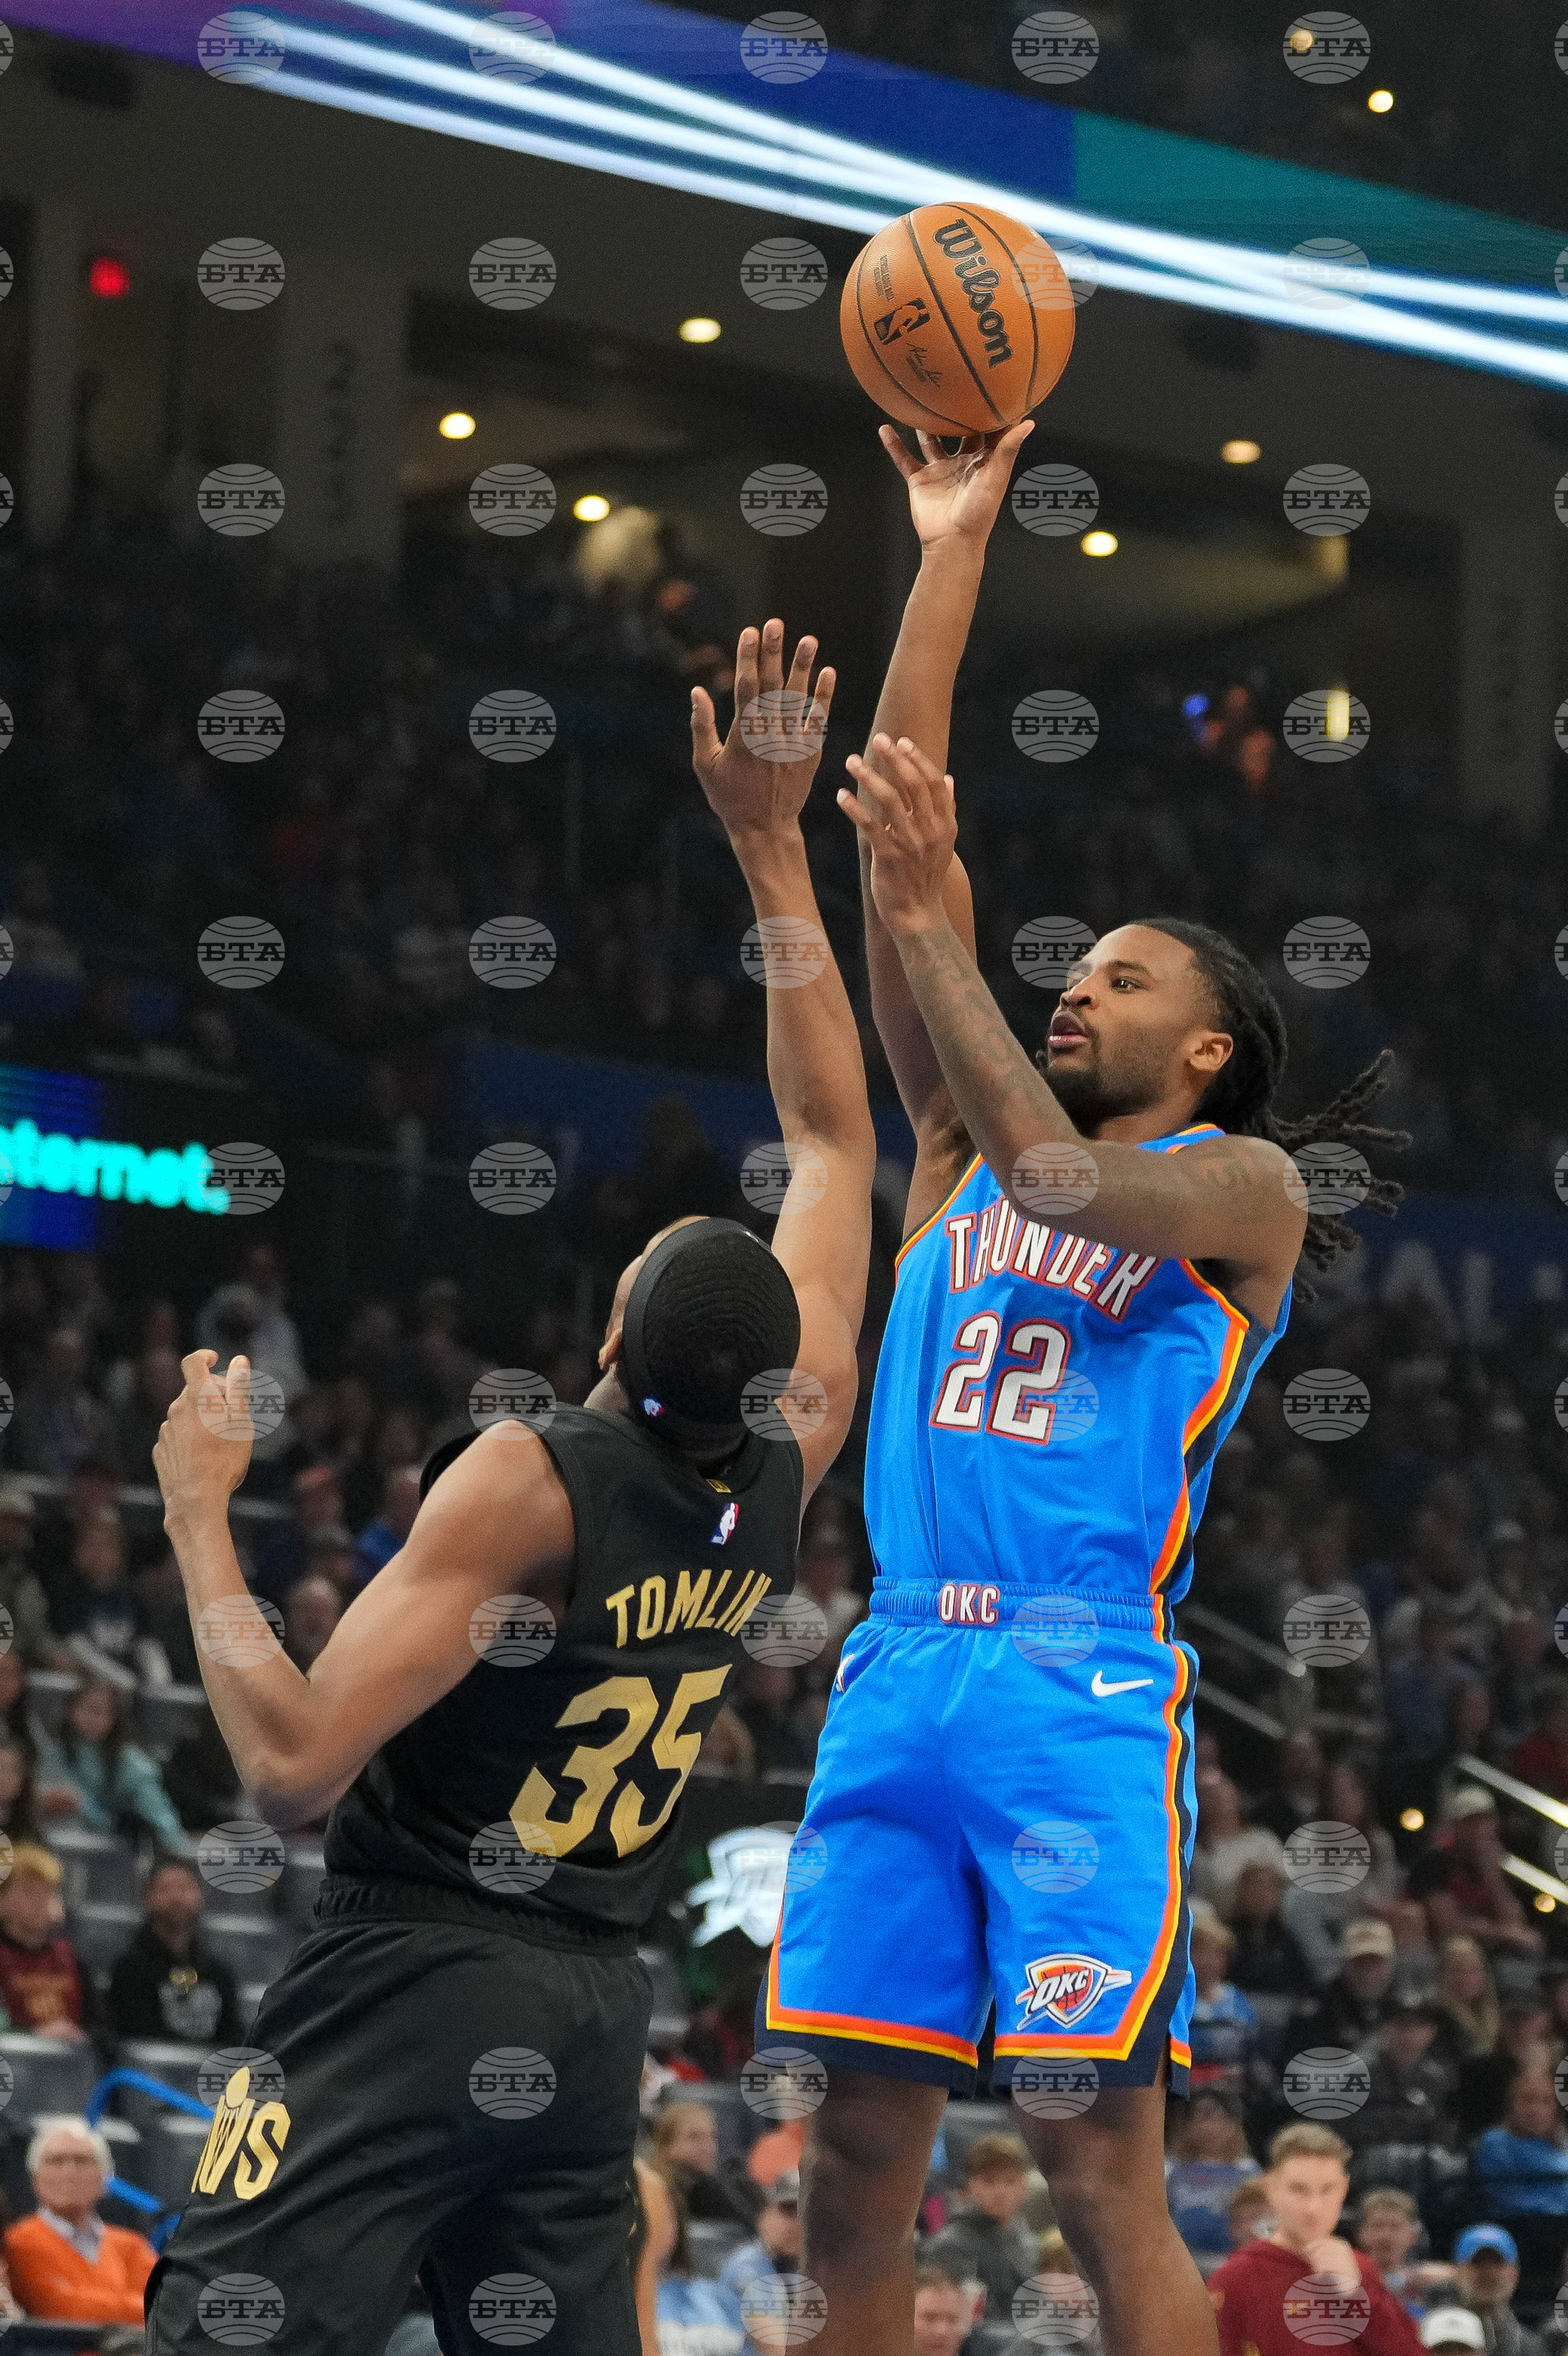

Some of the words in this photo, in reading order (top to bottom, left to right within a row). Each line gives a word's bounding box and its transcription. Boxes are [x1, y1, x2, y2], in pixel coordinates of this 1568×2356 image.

[933, 219, 1013, 369] Wilson
[945, 1195, 1162, 1323] THUNDER
[929, 1310, 1071, 1445] 22
[605, 1569, 773, 1649] TOMLIN
[939, 1583, 1001, 1625] OKC
[509, 1664, 733, 1858] 35
[1029, 1968, 1090, 2013] OKC
